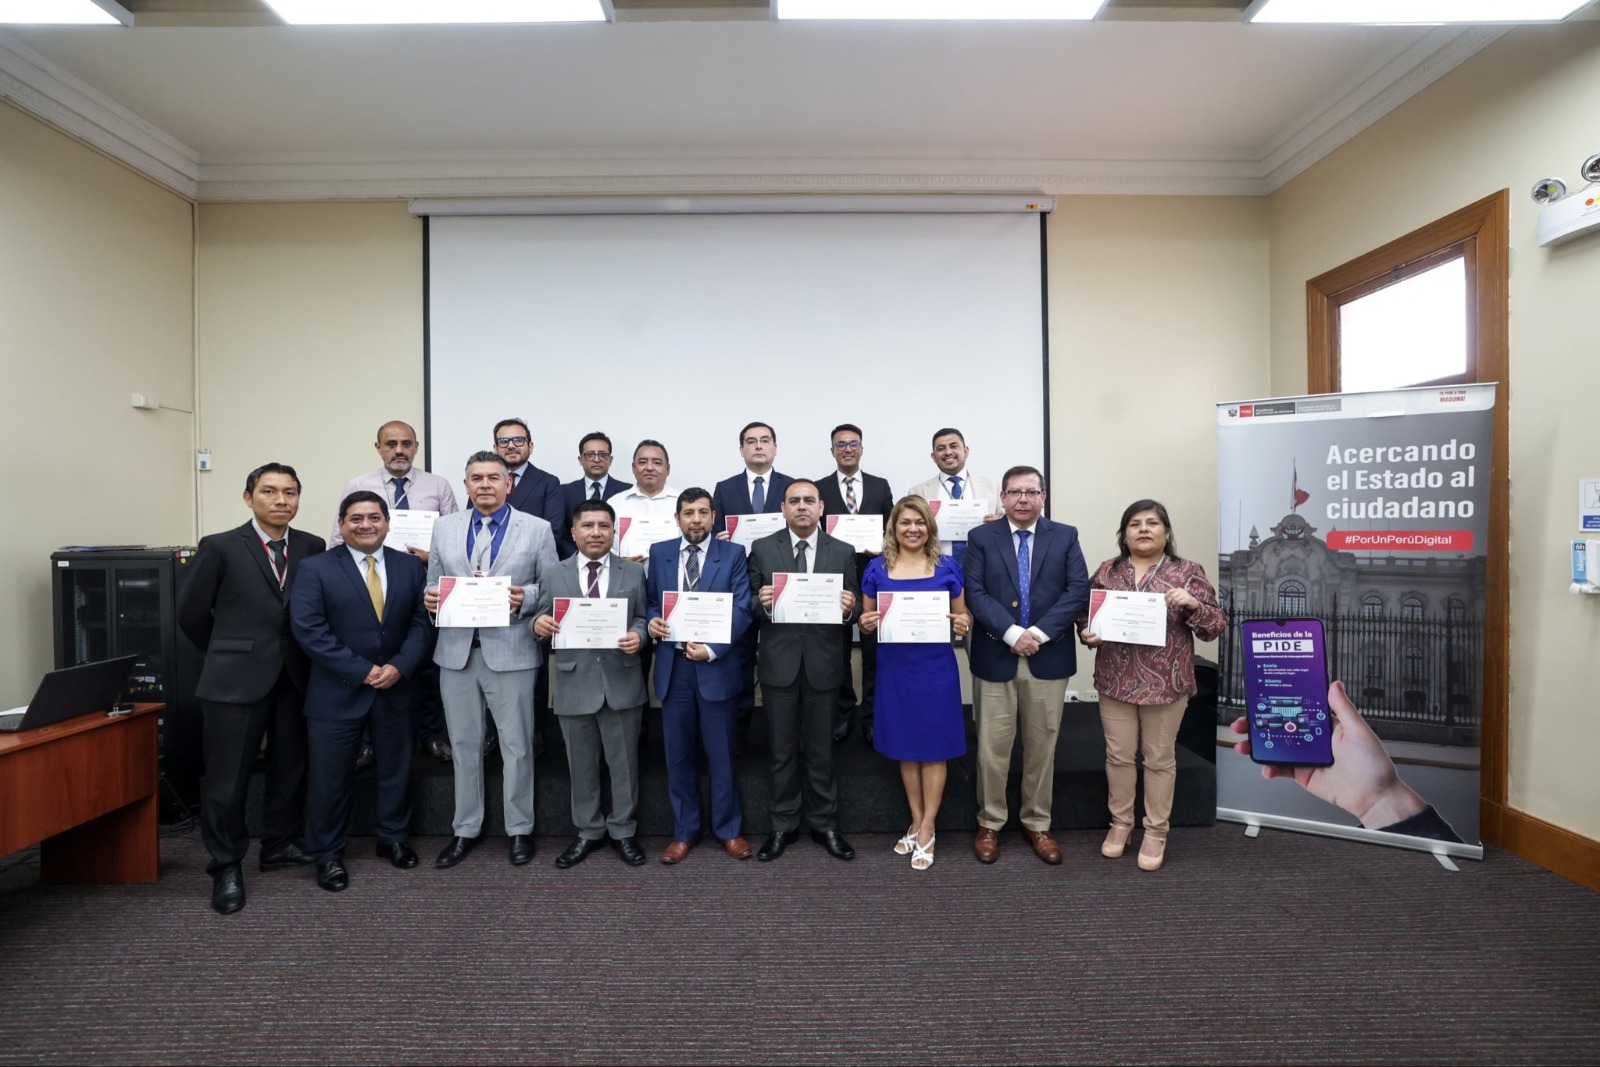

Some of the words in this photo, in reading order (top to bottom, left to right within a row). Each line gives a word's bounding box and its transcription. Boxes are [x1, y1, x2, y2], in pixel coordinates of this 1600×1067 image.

[1326, 439, 1476, 465] Acercando
[1327, 470, 1348, 490] el
[1356, 466, 1443, 490] Estado
[1450, 466, 1474, 488] al
[1326, 496, 1474, 520] ciudadano
[1345, 534, 1452, 546] #PorUnPerúDigital
[1264, 642, 1302, 652] PIDE
